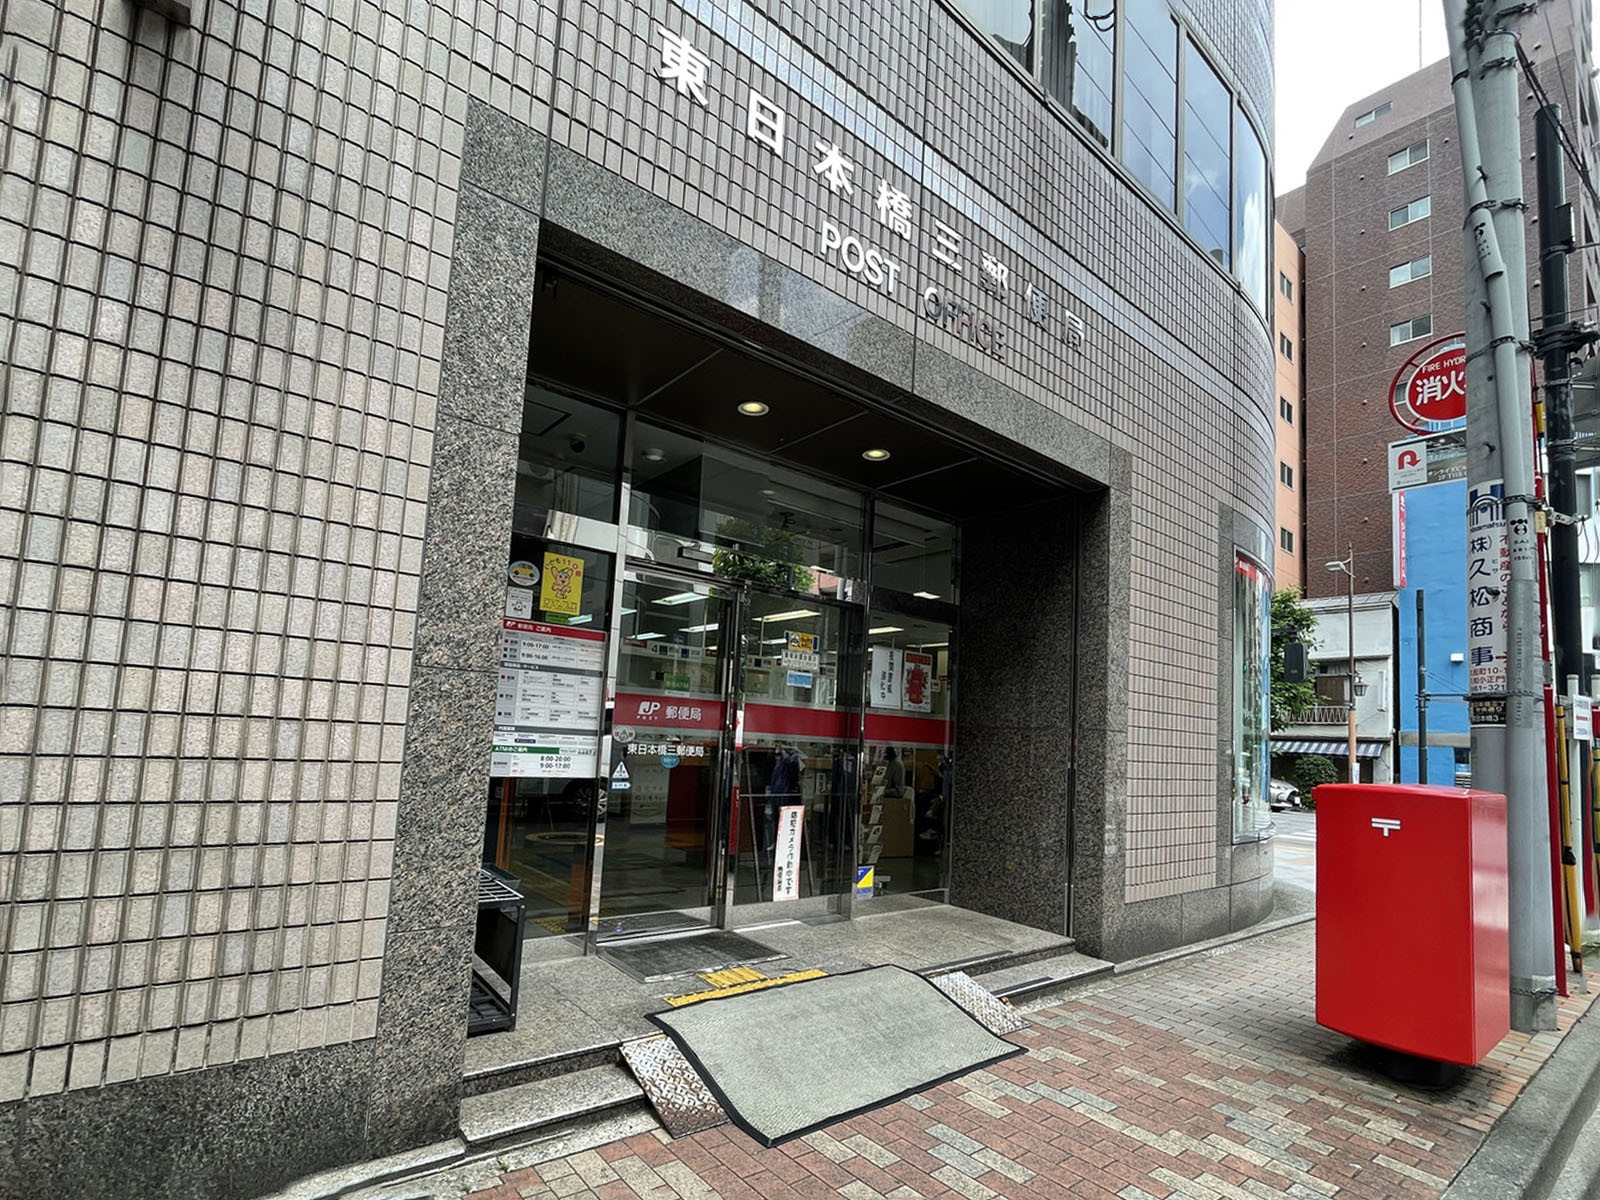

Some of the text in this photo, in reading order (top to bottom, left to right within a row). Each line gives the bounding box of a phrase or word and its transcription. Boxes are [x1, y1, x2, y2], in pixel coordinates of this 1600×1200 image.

[653, 25, 1085, 352] 東日本橋三郵便局
[819, 220, 1007, 361] POST OFFICE
[1422, 362, 1441, 373] FIRE
[1416, 370, 1466, 406] 消火
[665, 705, 702, 721] 郵便局
[627, 743, 704, 757] 東日本橋三郵便局
